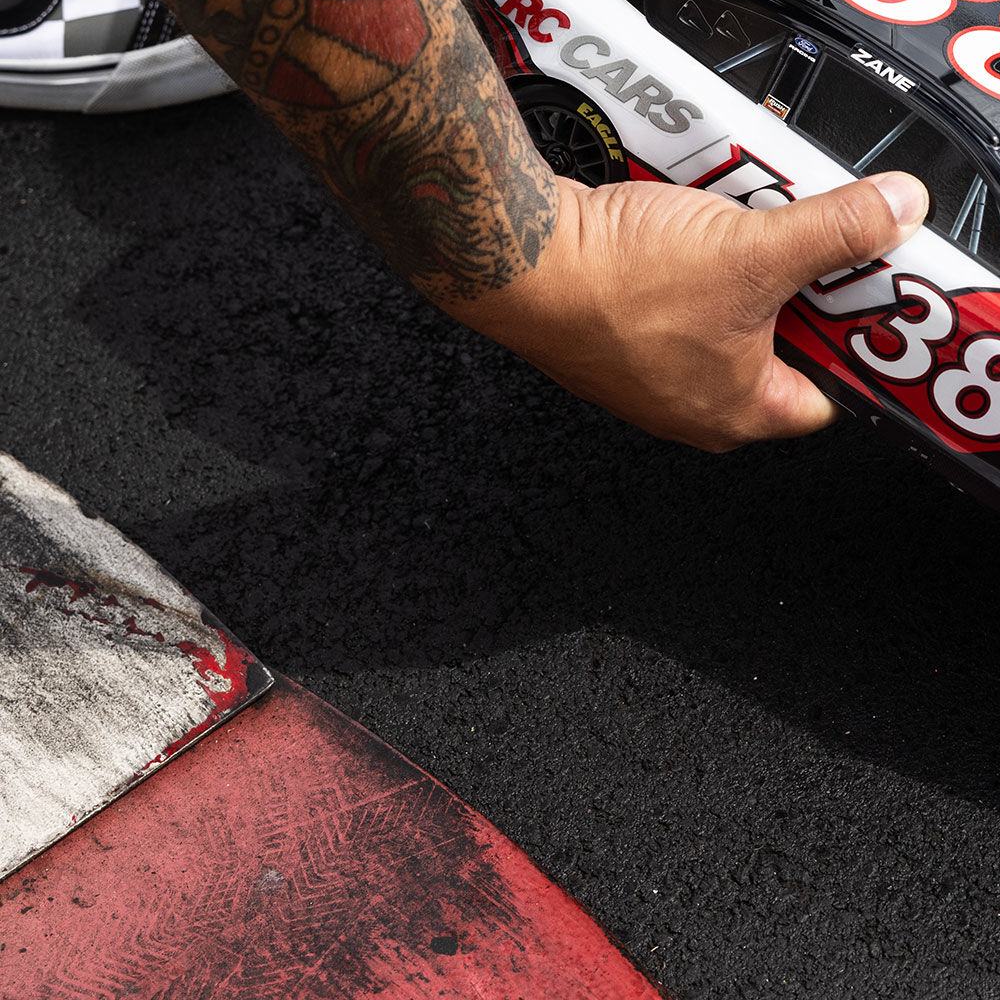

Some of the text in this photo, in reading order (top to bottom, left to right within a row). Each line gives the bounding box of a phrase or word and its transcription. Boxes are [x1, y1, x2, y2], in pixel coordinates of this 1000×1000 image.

[560, 35, 705, 134] CARS
[850, 48, 916, 93] ZANE
[577, 102, 624, 163] EAGLE
